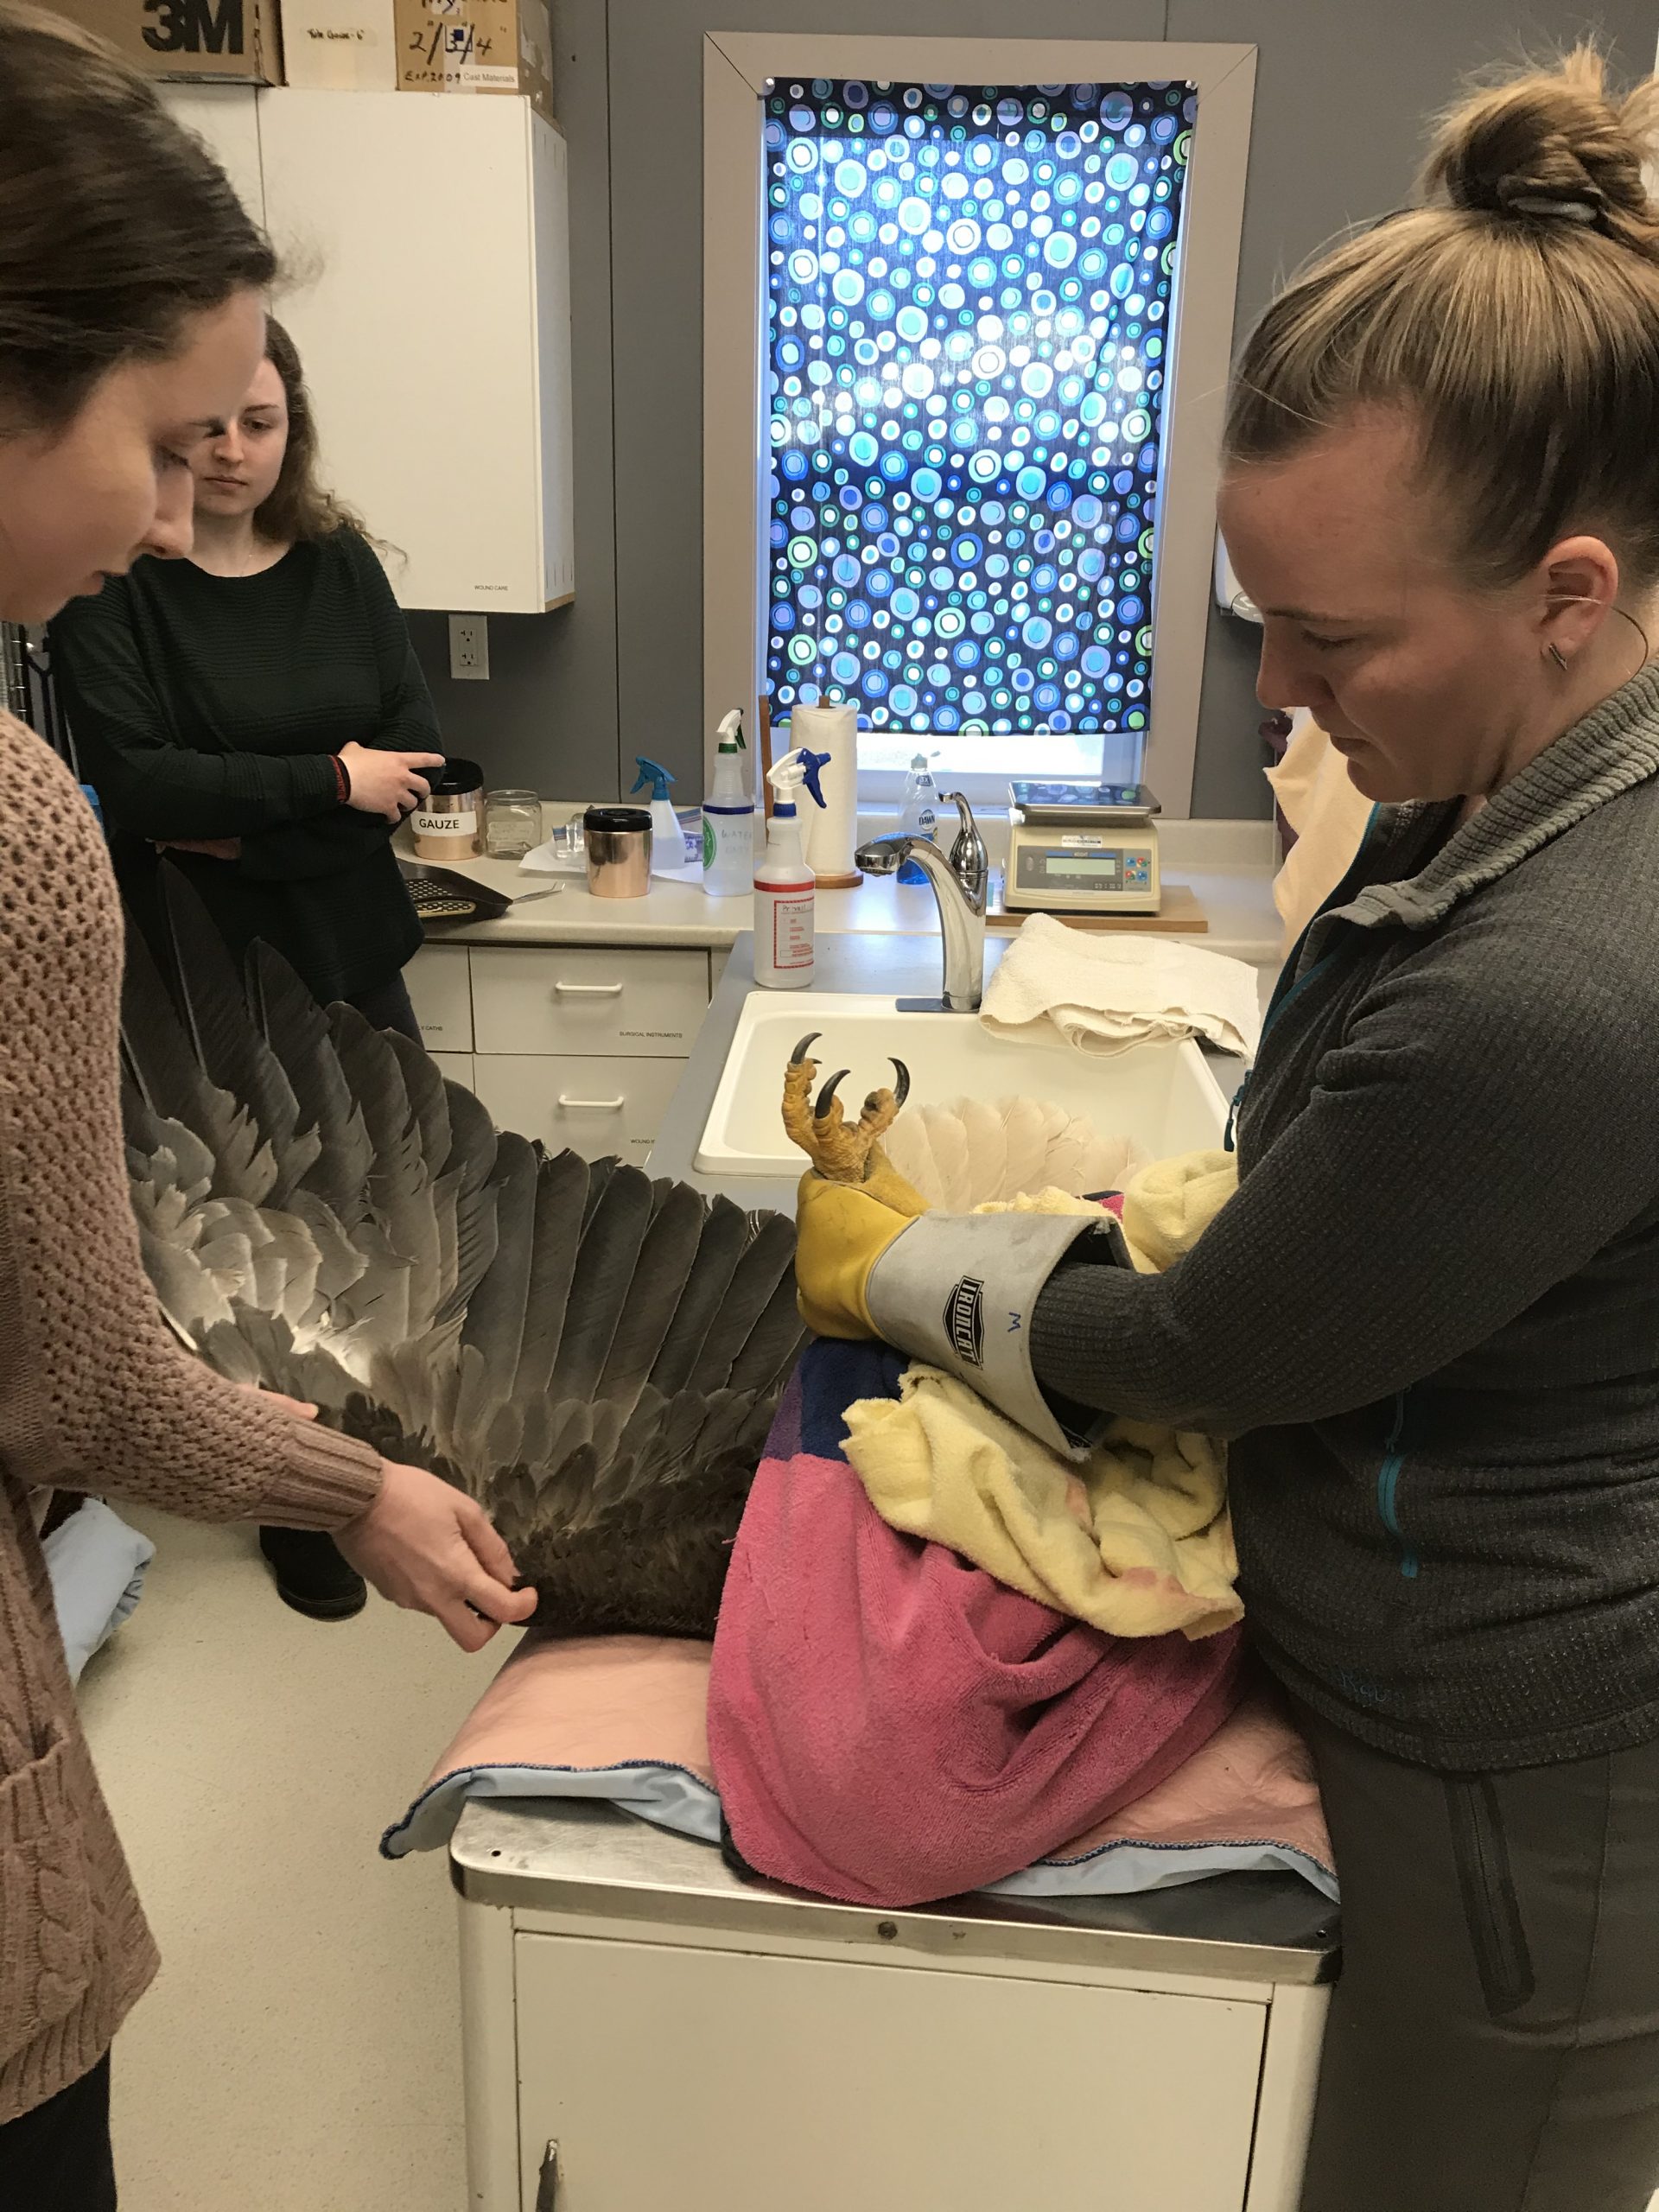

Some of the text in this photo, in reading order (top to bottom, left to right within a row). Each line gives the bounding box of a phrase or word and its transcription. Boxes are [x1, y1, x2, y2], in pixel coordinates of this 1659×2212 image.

[141, 0, 244, 54] 3M
[463, 72, 516, 83] Cast Materials
[419, 818, 460, 830] GAUZE
[918, 815, 936, 826] DAWN
[956, 1282, 977, 1363] IRONCAT
